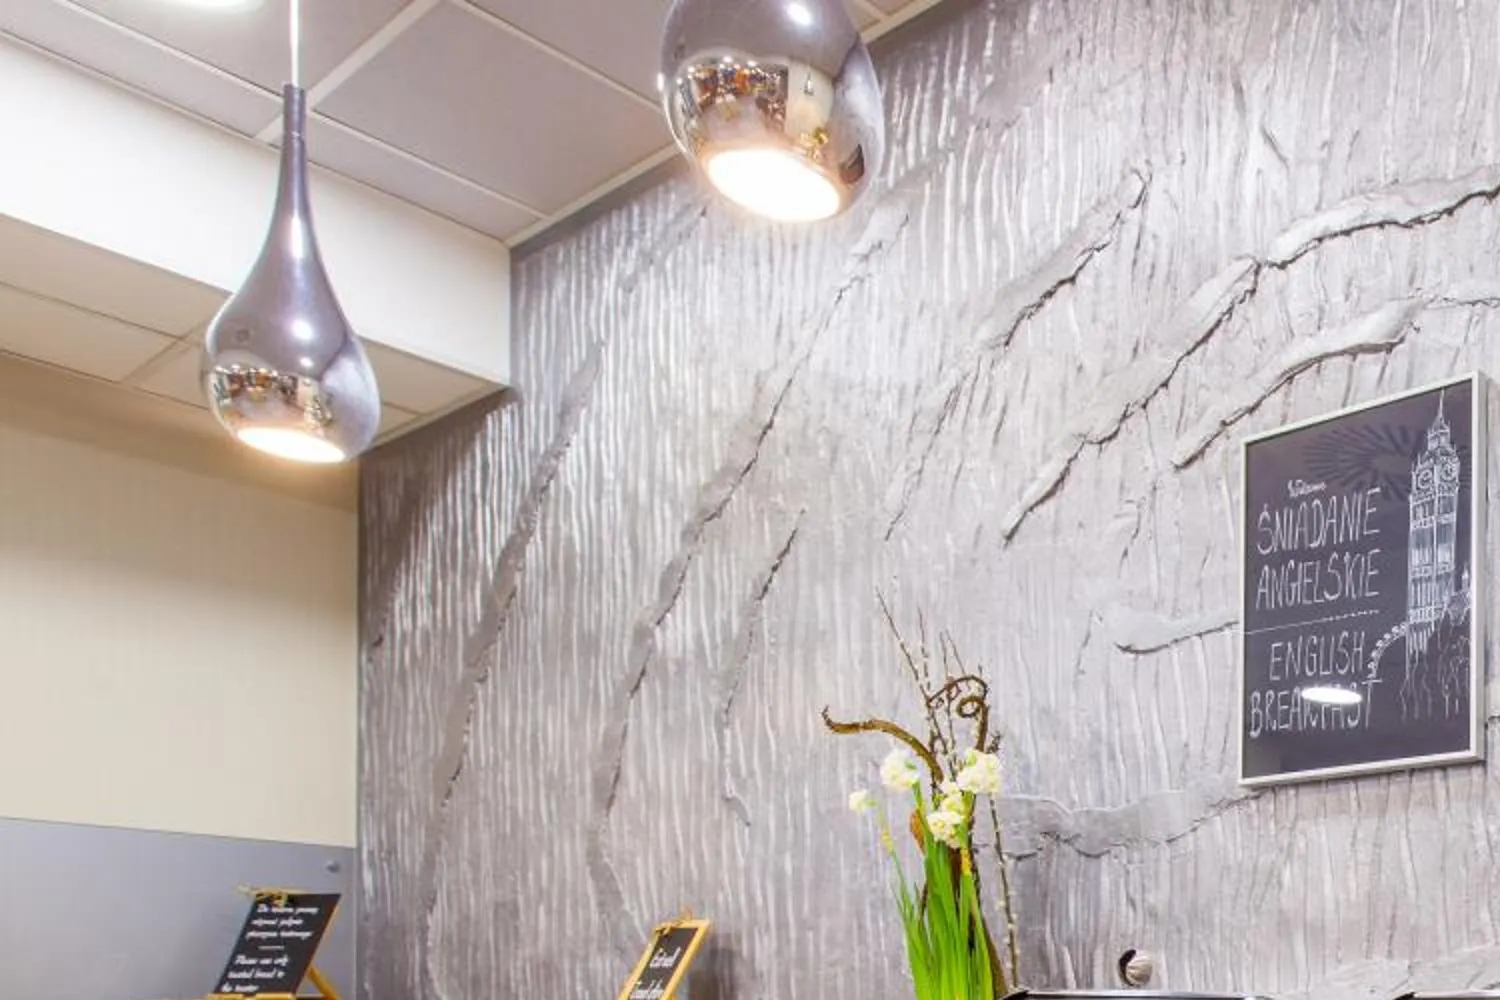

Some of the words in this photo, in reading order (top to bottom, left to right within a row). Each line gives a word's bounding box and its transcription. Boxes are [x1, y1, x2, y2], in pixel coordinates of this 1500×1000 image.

[1256, 486, 1381, 555] ŚNIADANIE
[1256, 548, 1381, 610] ANGIELSKIE
[1269, 631, 1366, 681] ENGLISH
